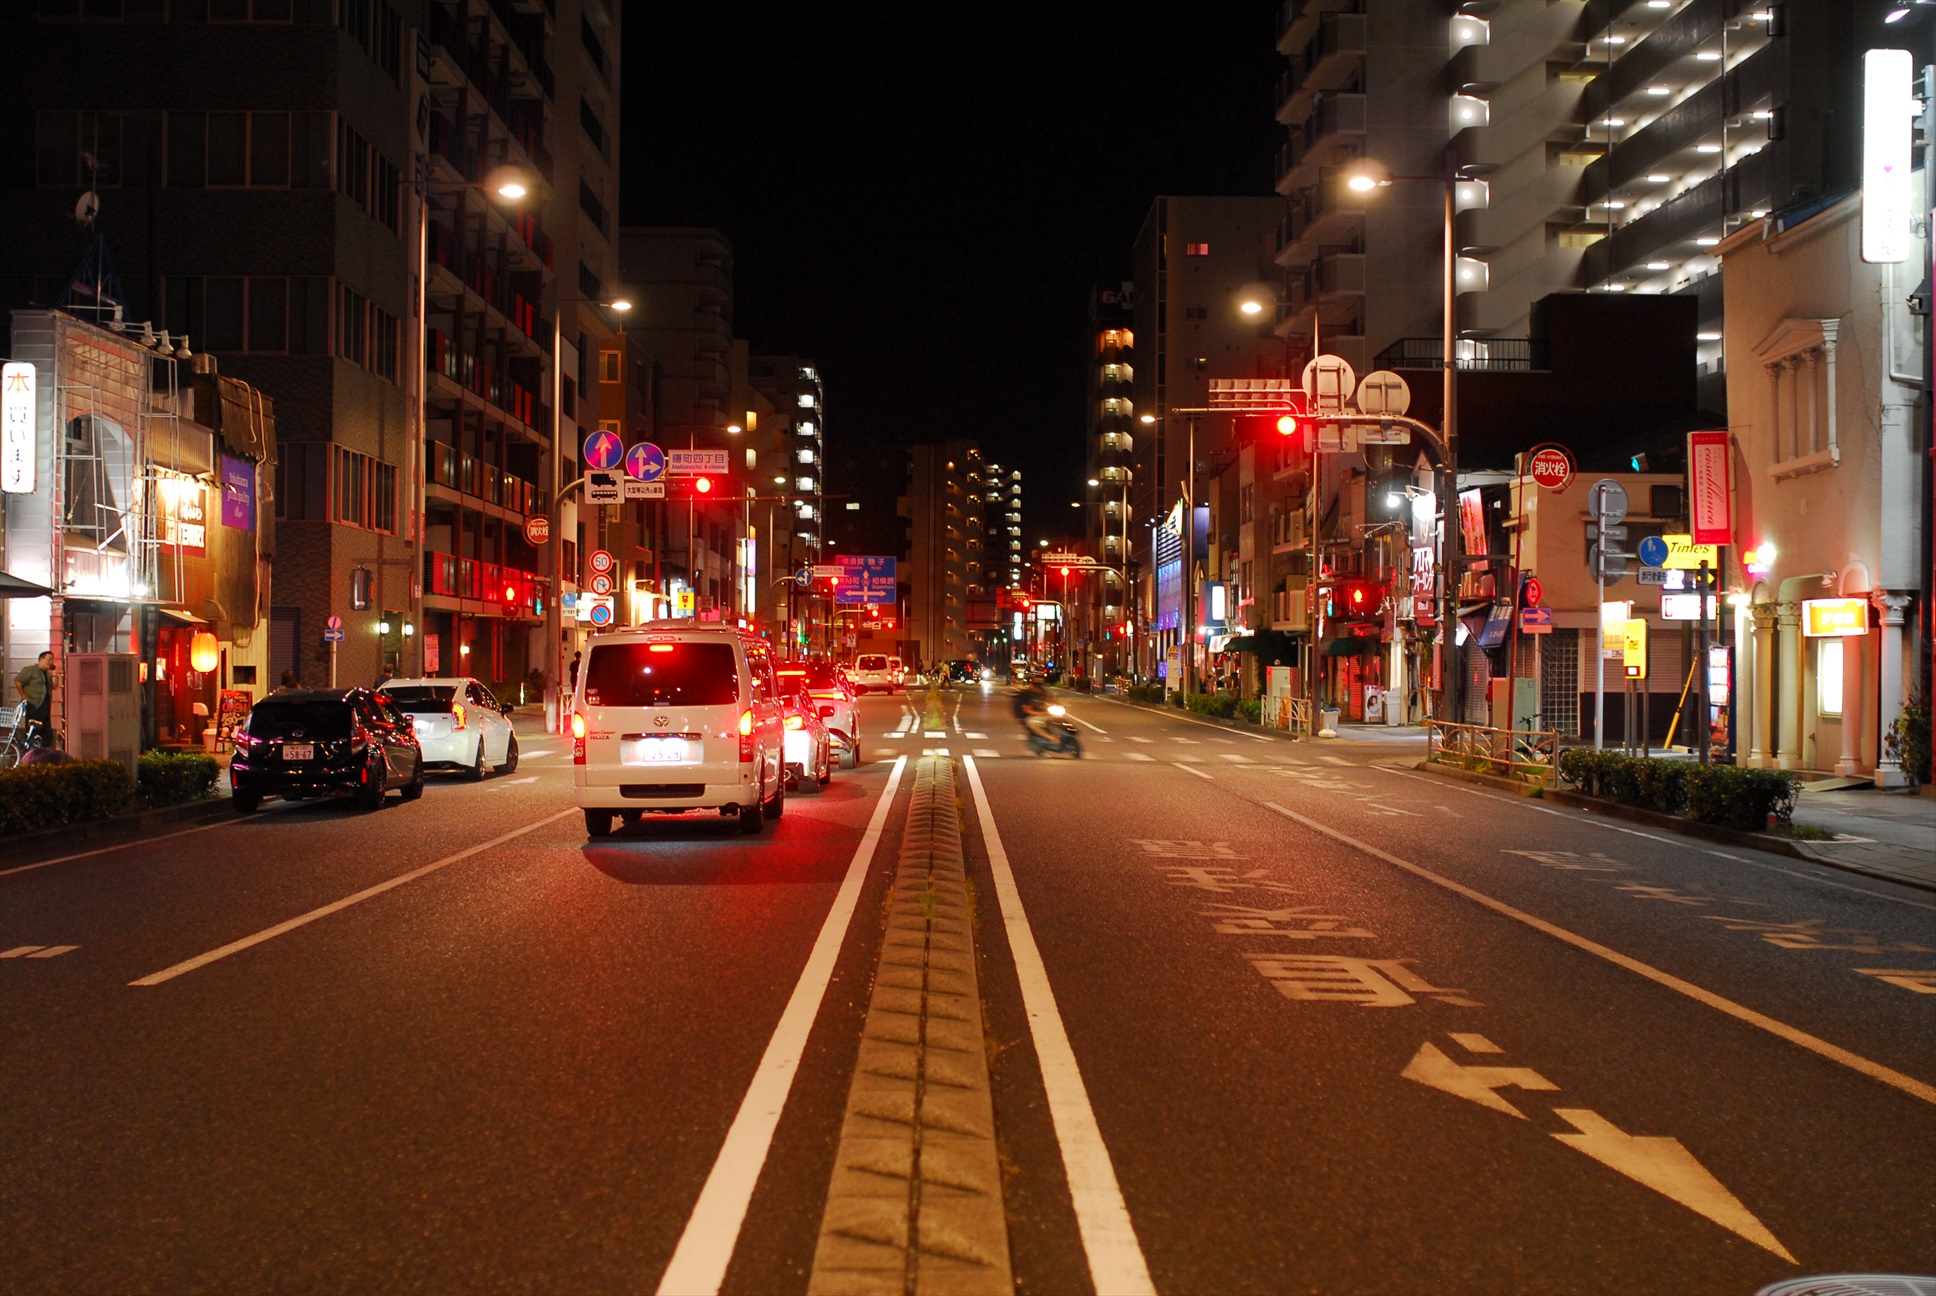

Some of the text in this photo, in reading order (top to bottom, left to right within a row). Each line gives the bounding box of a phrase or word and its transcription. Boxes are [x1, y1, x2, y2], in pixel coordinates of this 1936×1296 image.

[1535, 461, 1566, 477] 消火栓
[1705, 447, 1725, 526] casablanca
[595, 557, 608, 567] 50
[290, 750, 312, 759] 58-67
[1131, 838, 1486, 1007] 追突注意
